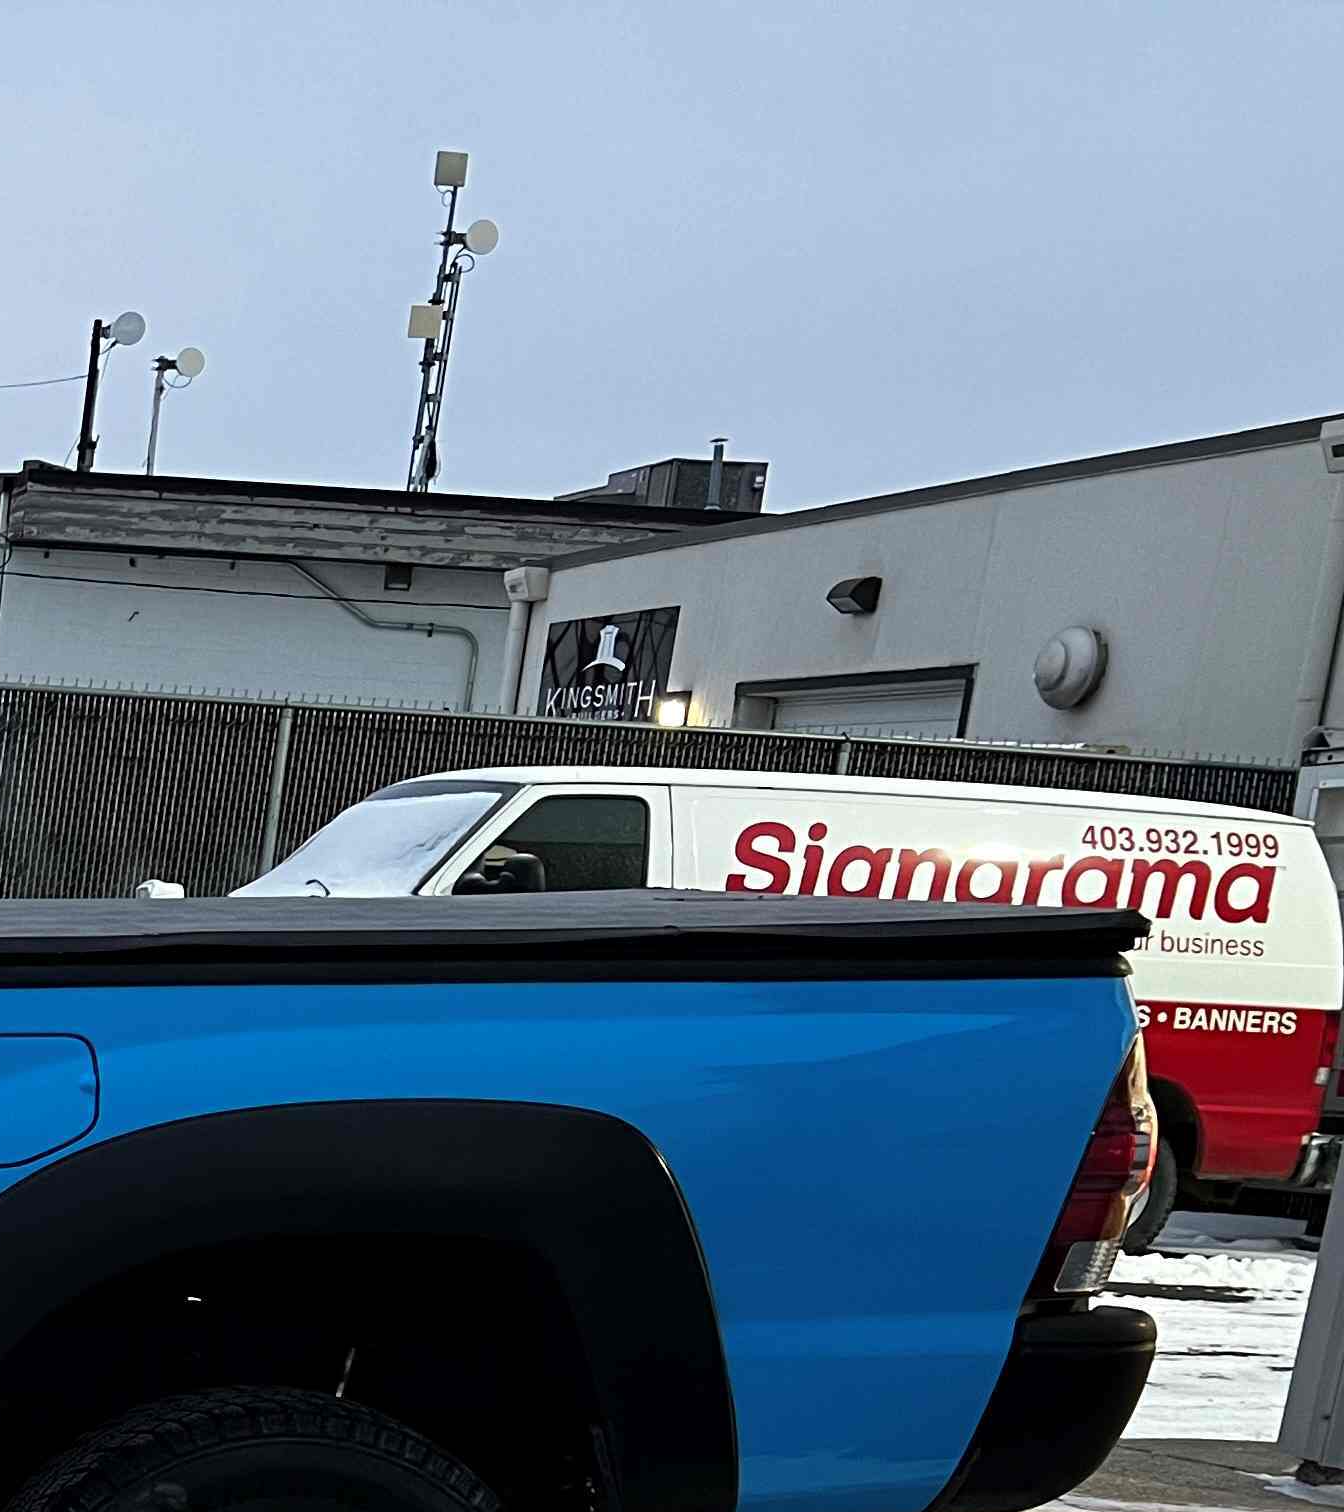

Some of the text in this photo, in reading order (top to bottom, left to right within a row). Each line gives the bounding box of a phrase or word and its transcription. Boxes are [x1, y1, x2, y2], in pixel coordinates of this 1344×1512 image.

[545, 680, 656, 718] KINGSMITH
[1081, 825, 1280, 858] 403.932.1999
[1161, 929, 1265, 957] business
[1173, 1007, 1298, 1035] BANNERS
